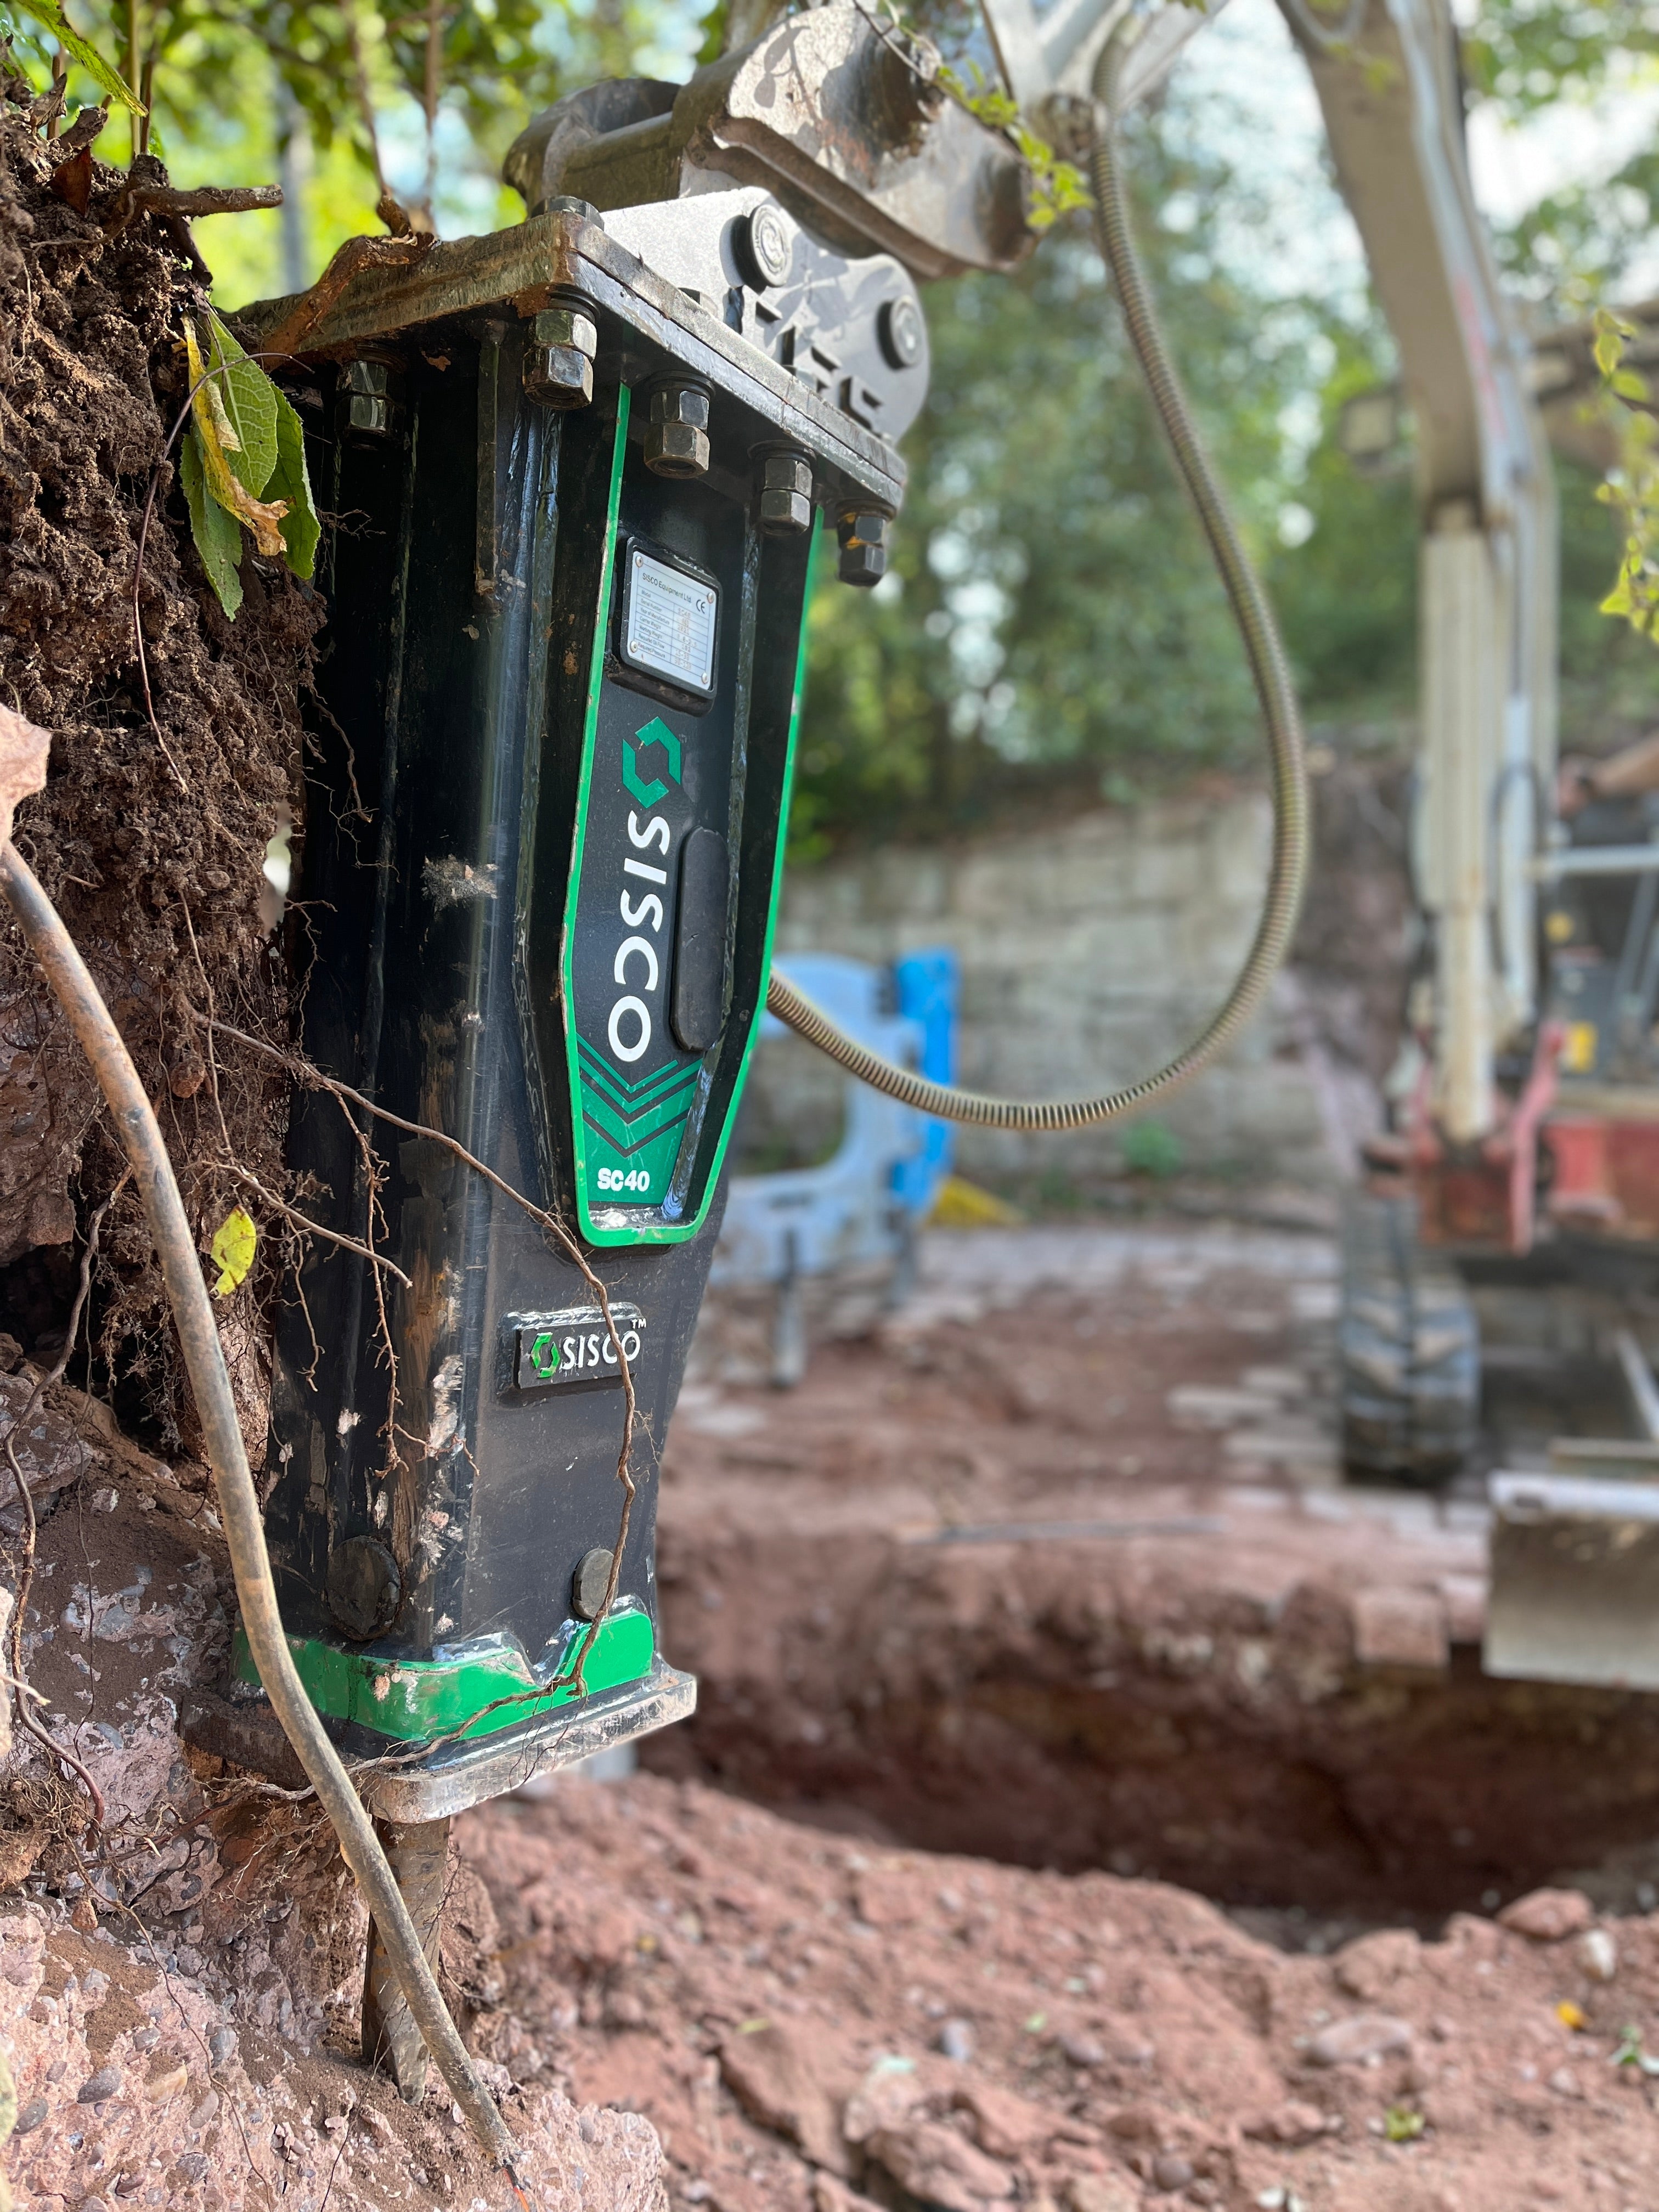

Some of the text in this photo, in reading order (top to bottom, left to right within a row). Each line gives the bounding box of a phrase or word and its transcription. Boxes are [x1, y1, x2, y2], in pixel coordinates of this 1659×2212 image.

[642, 572, 658, 585] SISCO
[658, 580, 683, 599] Equipment
[650, 603, 662, 612] Number
[696, 599, 706, 614] CE
[651, 611, 670, 625] Manufacture
[639, 624, 652, 635] Working
[639, 633, 652, 644] Required
[637, 642, 665, 658] Required Pressure
[607, 810, 670, 1063] SISCO
[597, 1167, 650, 1192] SC40
[560, 1318, 647, 1370] SISCO TM
